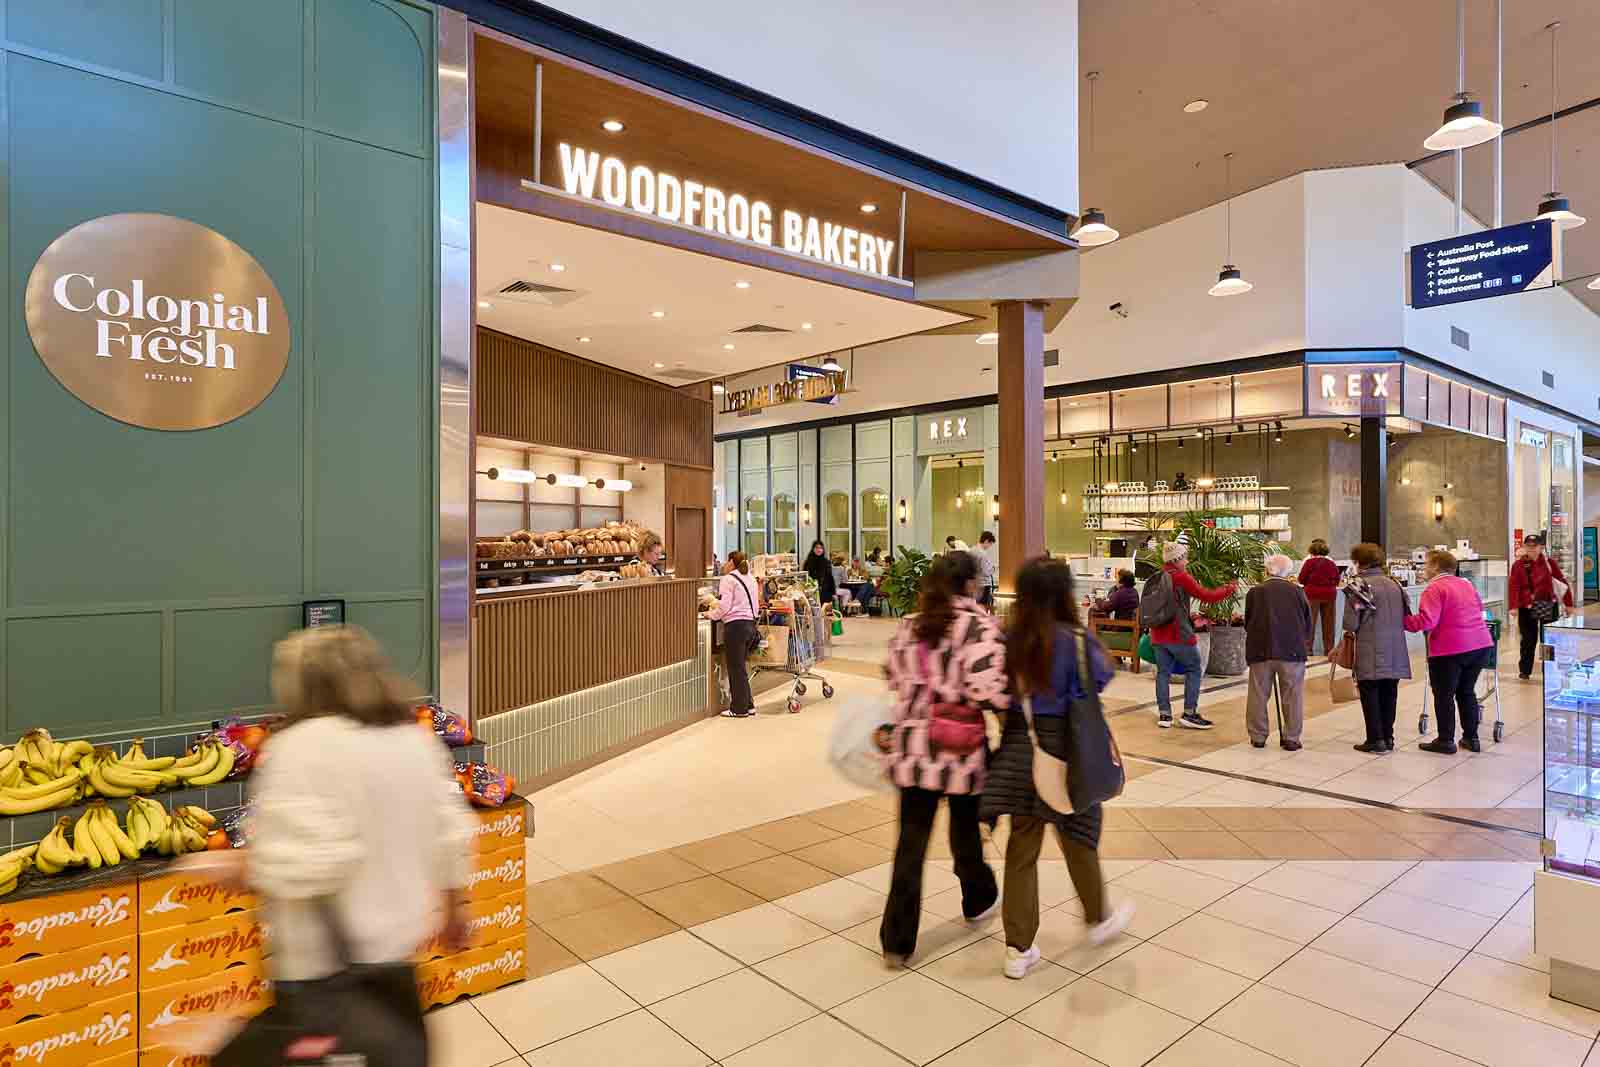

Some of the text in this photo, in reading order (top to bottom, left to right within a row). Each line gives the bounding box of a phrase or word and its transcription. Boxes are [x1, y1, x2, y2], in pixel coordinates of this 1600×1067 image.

[559, 142, 895, 277] WOODFROG BAKERY
[1437, 240, 1494, 257] Australia Post
[1437, 244, 1528, 266] Takeaway Food Shops
[1438, 266, 1460, 276] Coles
[1438, 272, 1483, 286] Food Court
[53, 273, 271, 337] Colonial
[1438, 282, 1481, 296] Restrooms
[96, 319, 237, 370] Fresh
[1321, 374, 1388, 398] REX
[930, 416, 967, 440] REX
[14, 896, 130, 942] Karadoc
[178, 927, 261, 960] Melons
[14, 953, 131, 1003] Karadoc
[454, 950, 524, 984] Karadoc
[177, 977, 261, 1015] Melons
[14, 1012, 132, 1063] Karadoc
